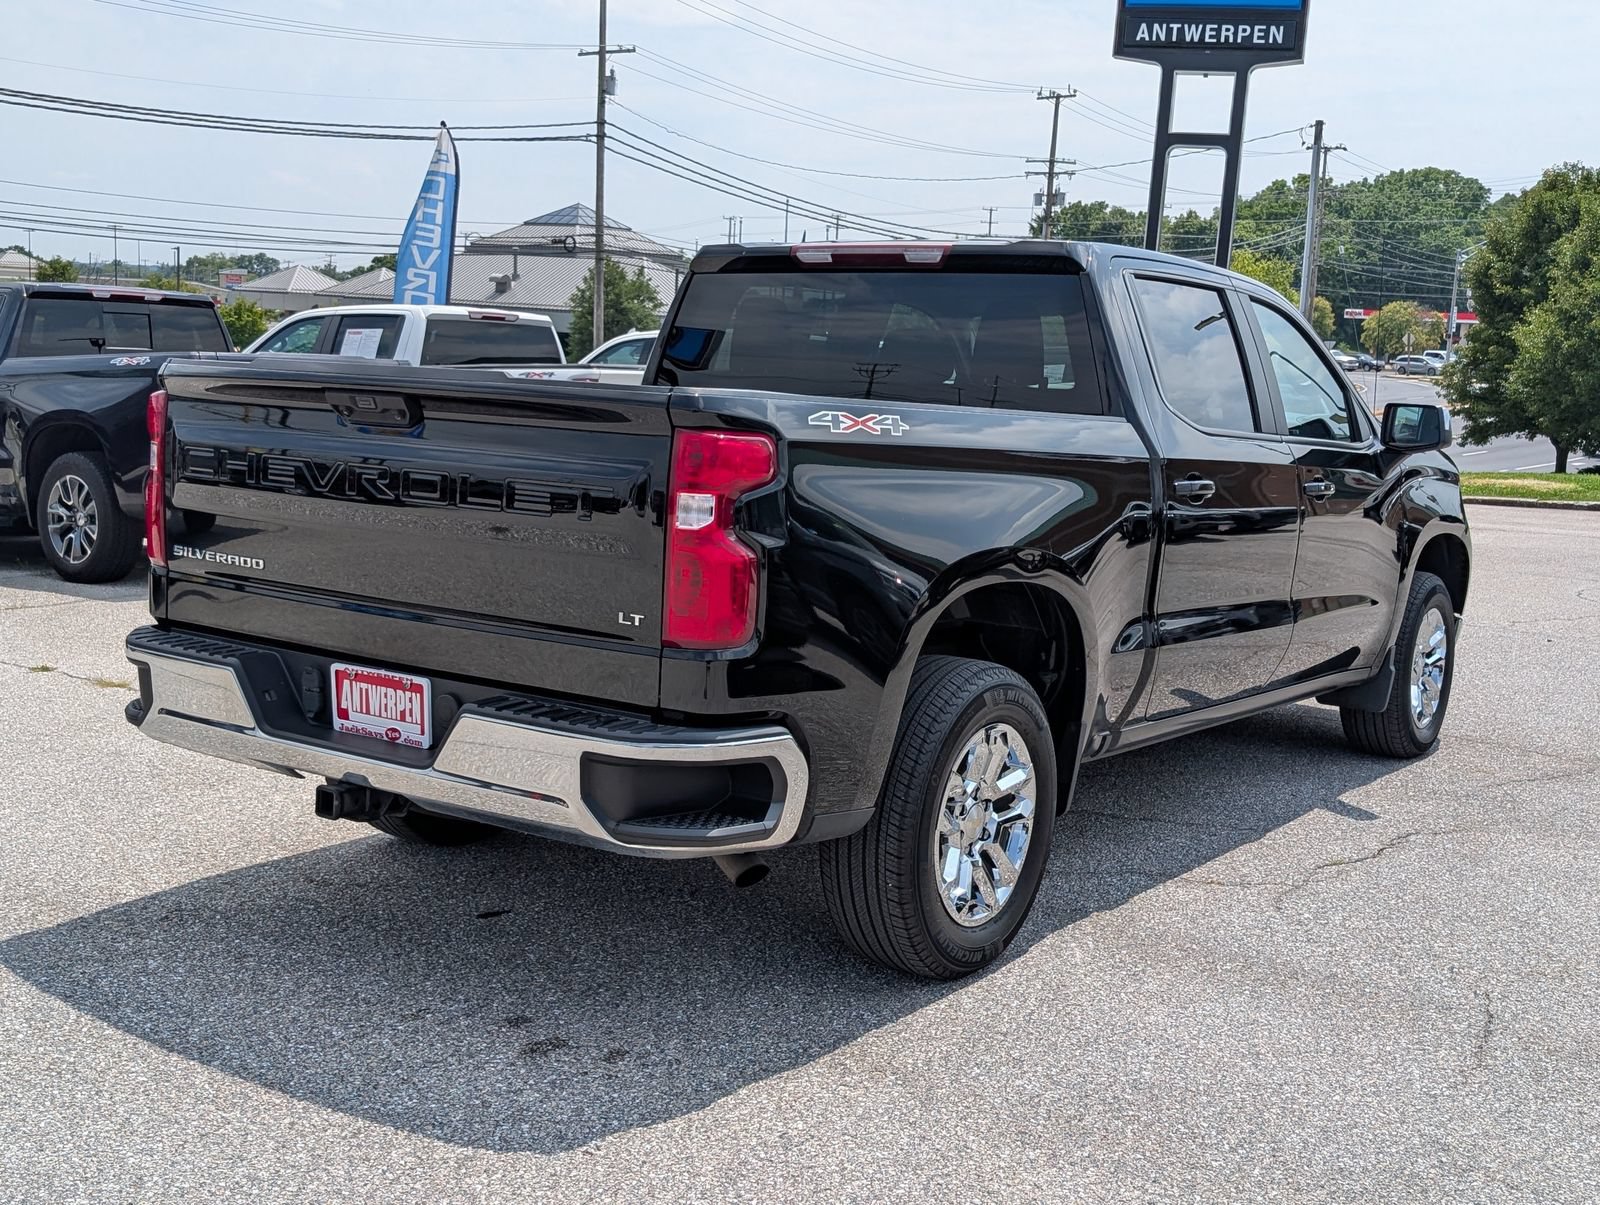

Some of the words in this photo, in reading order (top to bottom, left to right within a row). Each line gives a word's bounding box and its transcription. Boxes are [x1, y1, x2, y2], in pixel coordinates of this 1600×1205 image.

[1135, 22, 1285, 44] ANTWERPEN
[182, 445, 617, 521] CHEVROLET
[173, 545, 265, 570] SILVERADO
[618, 611, 645, 626] LT
[340, 679, 421, 724] ANTWERPEN
